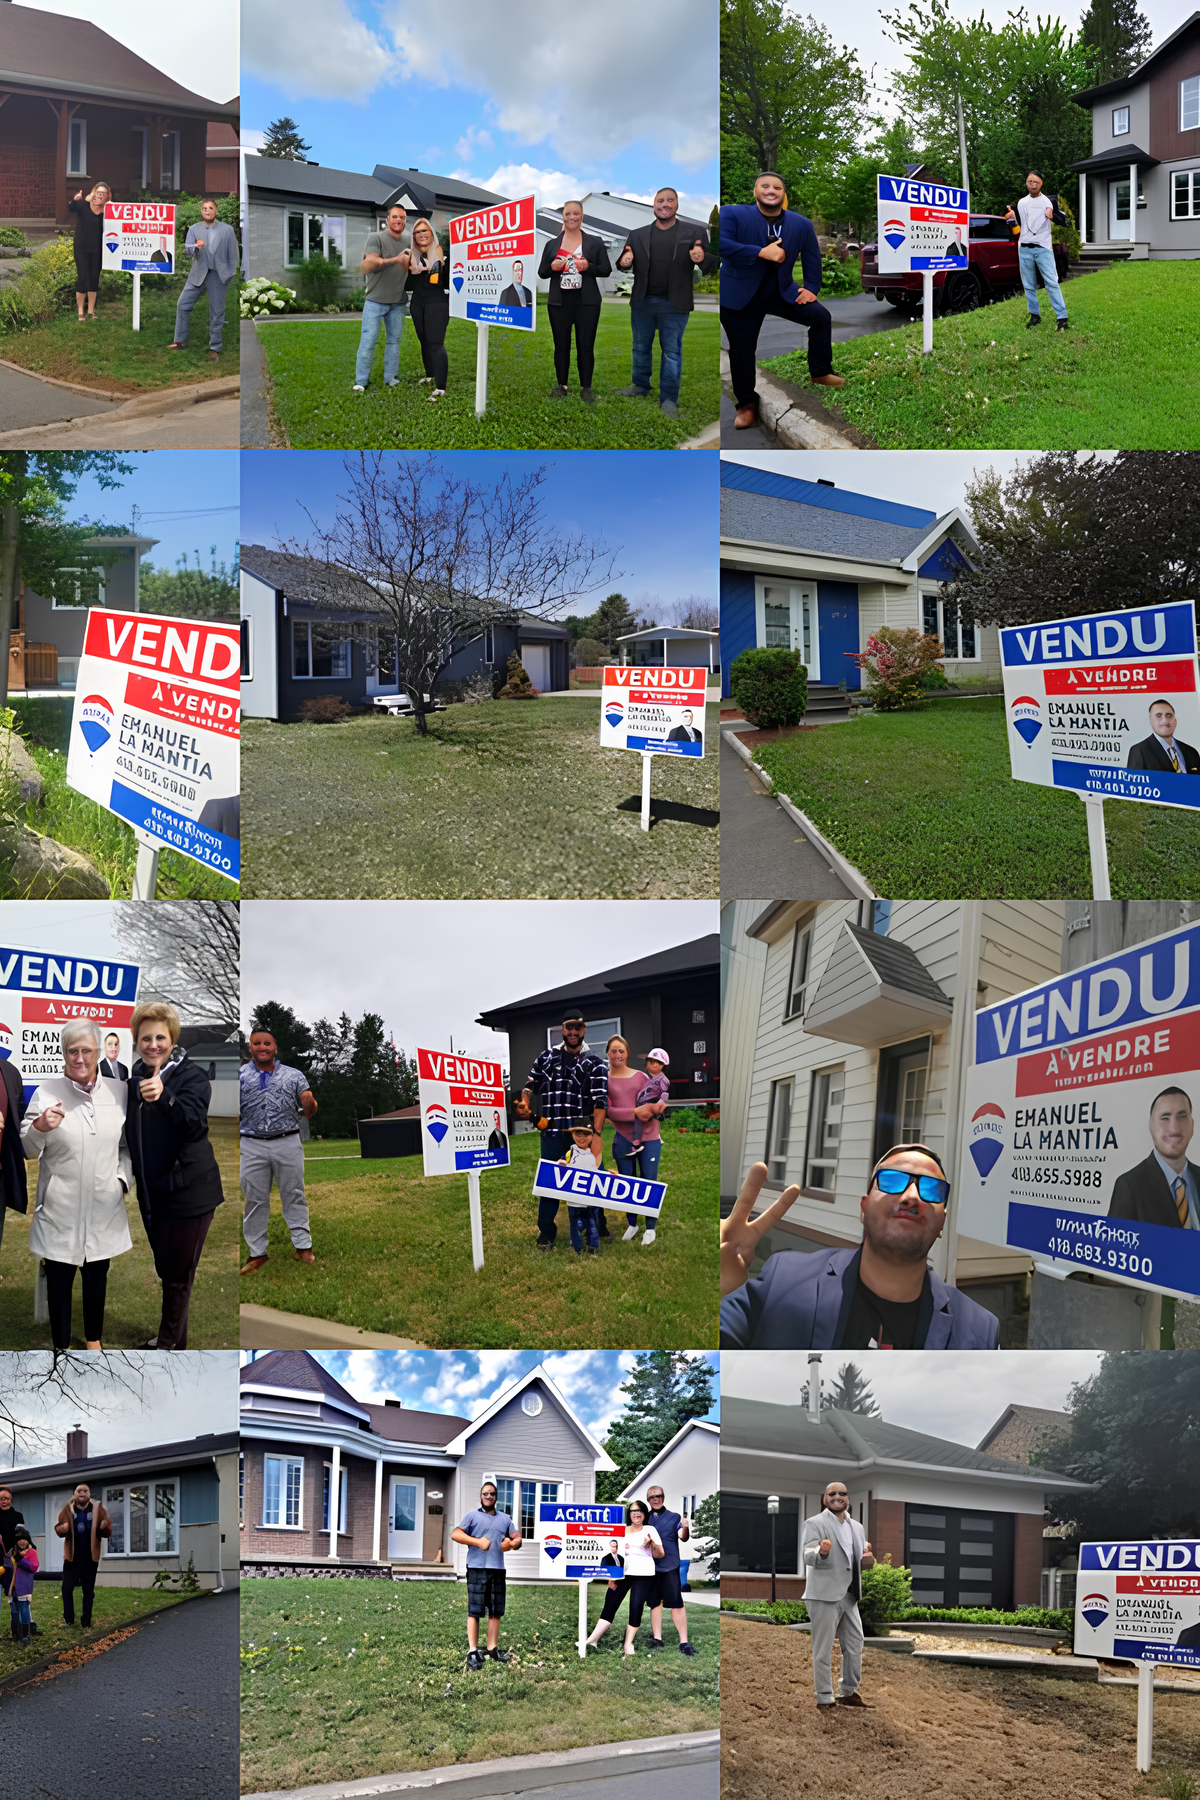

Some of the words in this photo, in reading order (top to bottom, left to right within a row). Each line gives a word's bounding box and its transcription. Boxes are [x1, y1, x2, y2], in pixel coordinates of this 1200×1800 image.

[890, 180, 960, 207] VENDU
[112, 205, 167, 219] VENDU
[455, 203, 520, 241] VENDU
[1015, 612, 1166, 662] VENDU
[615, 669, 695, 687] VENDU
[122, 714, 200, 755] EMANUEL
[120, 730, 136, 748] LA
[142, 740, 212, 780] MANTIA
[992, 939, 1190, 1055] VENDU
[22, 1044, 38, 1055] LA
[1068, 1029, 1170, 1071] VENDRE
[427, 1053, 495, 1085] VENDU
[1015, 1101, 1102, 1128] EMANUEL
[1013, 1132, 1033, 1150] LA
[1038, 1127, 1119, 1150] MANTIA
[553, 1166, 651, 1204] VENDU
